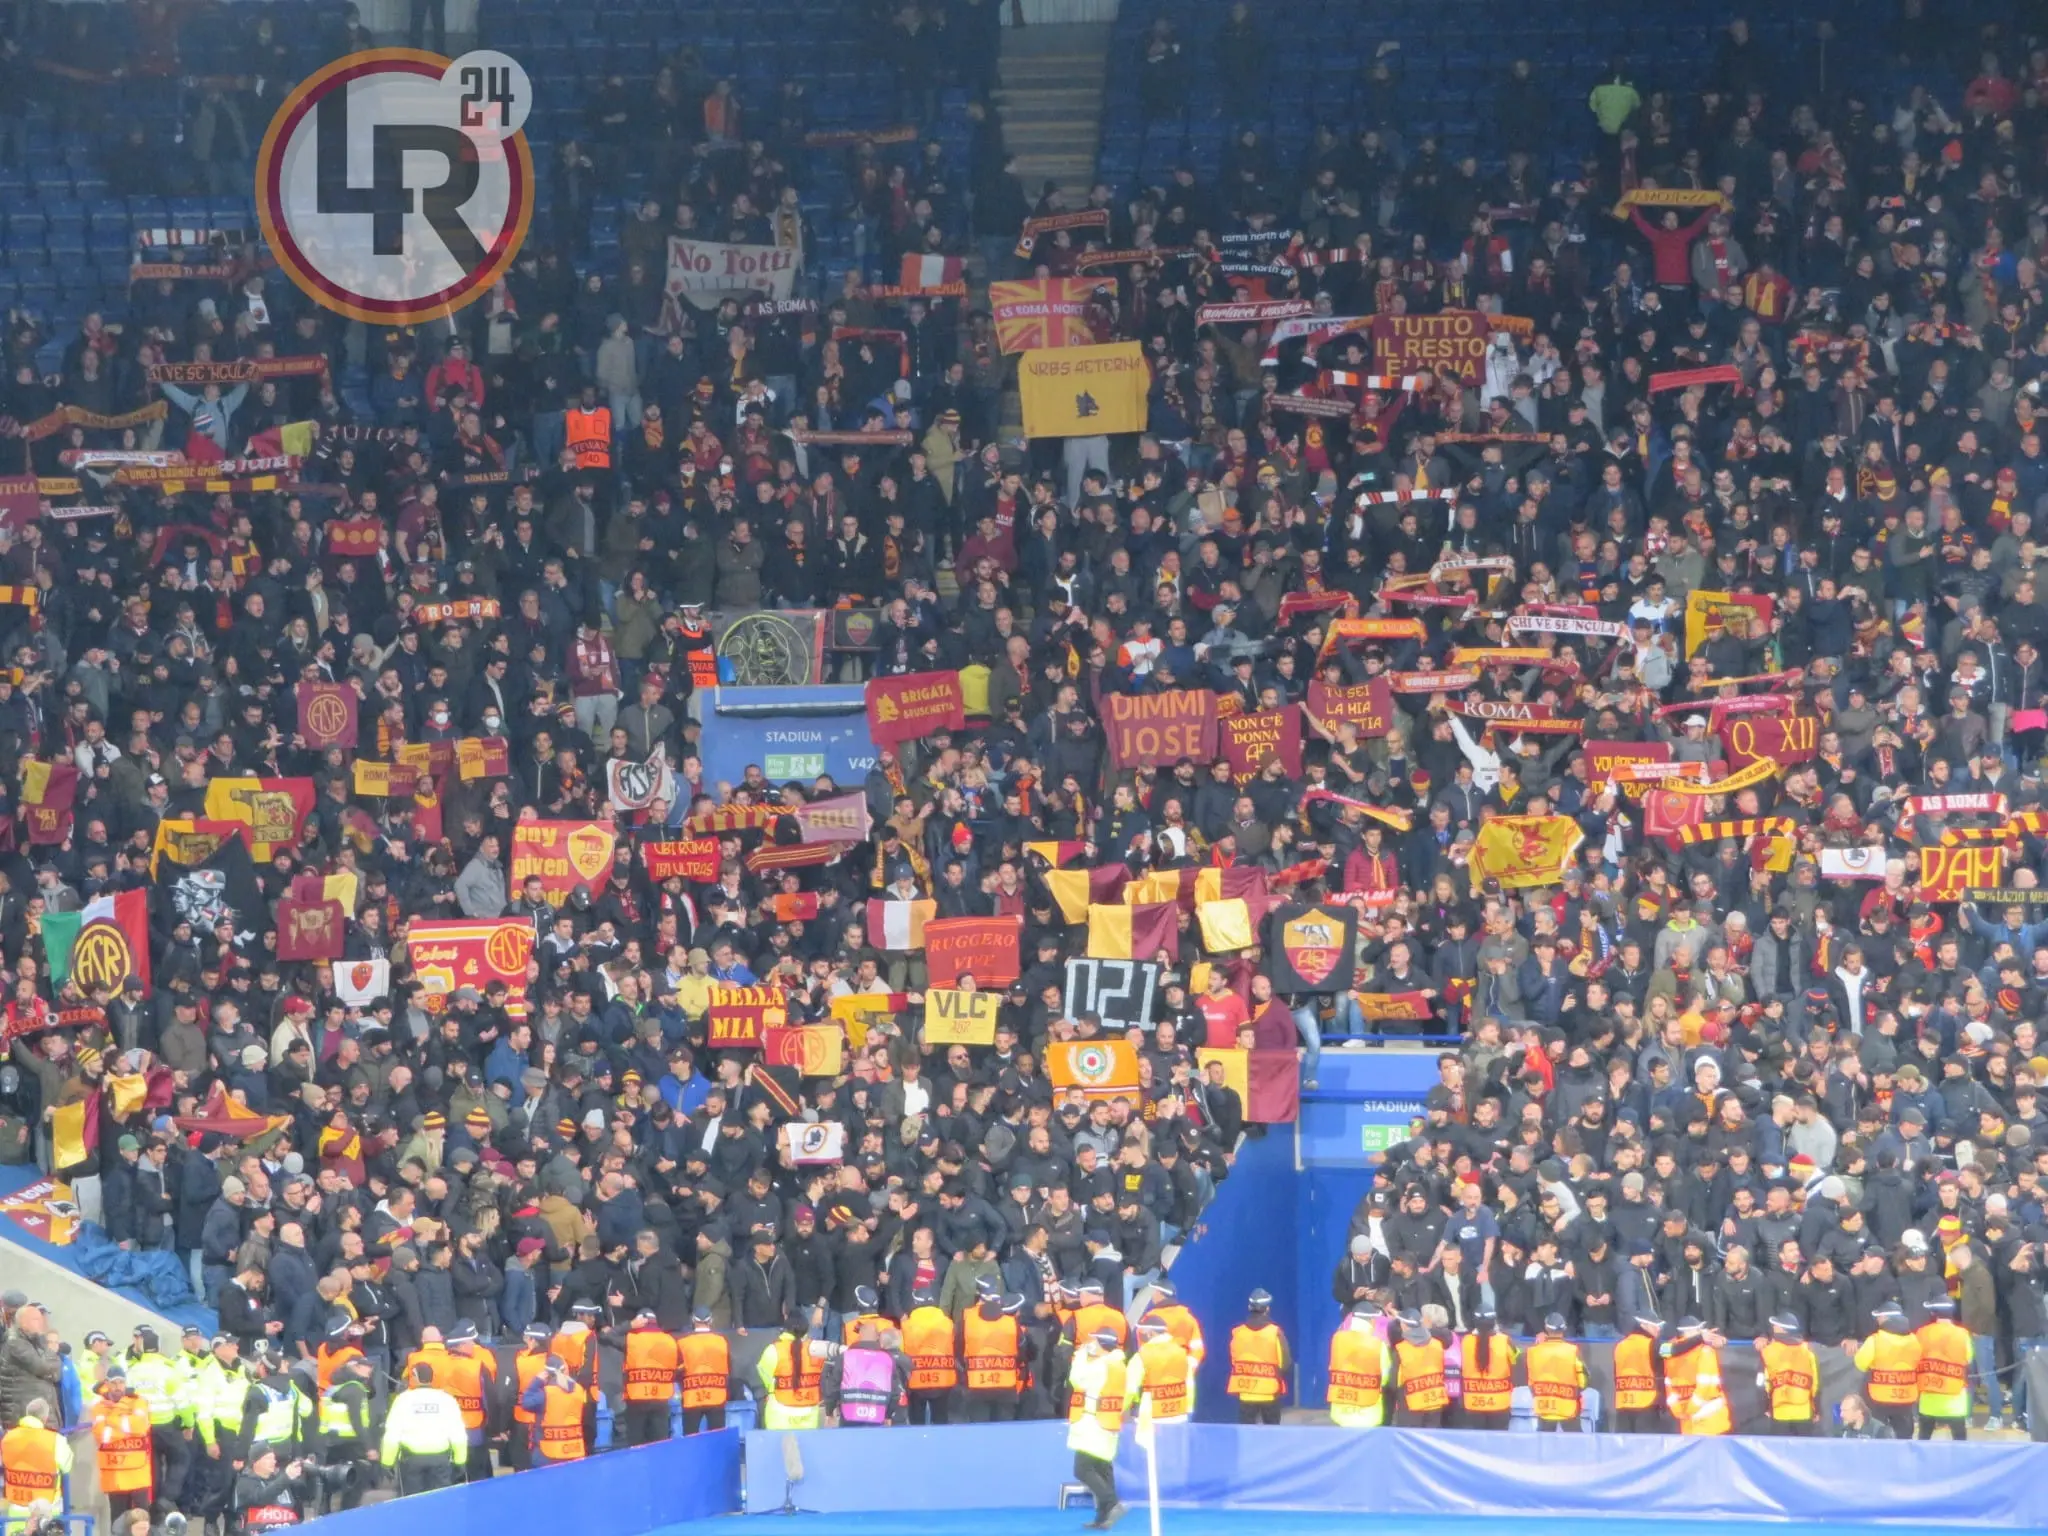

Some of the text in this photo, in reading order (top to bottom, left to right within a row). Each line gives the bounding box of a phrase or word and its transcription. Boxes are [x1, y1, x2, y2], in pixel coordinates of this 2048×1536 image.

[671, 243, 793, 275] No Totti
[758, 299, 807, 315] AS ROMA
[1016, 305, 1049, 317] ROMA
[1052, 304, 1085, 316] NORT
[1389, 316, 1473, 337] TUTTO
[1376, 337, 1487, 358] IL RESTO
[1511, 617, 1534, 629] CHI
[1536, 618, 1553, 630] VE
[1555, 619, 1571, 631] SE
[901, 683, 953, 704] BRIGATA
[1347, 684, 1370, 698] SEI
[1112, 690, 1205, 720] DIMMI
[1326, 702, 1343, 715] LA
[1463, 702, 1533, 719] ROMA
[311, 698, 343, 731] ASR
[1228, 717, 1260, 731] NON
[766, 731, 822, 743] STADIUM
[1233, 730, 1281, 745] DONNA
[1732, 717, 1814, 760] Q XII
[1921, 794, 1989, 811] AS ROMA
[514, 825, 558, 848] any
[514, 856, 568, 880] given
[673, 862, 713, 877] ULTRAS
[1921, 846, 2000, 889] DAM
[930, 932, 1016, 953] RUGGERO
[78, 935, 121, 986] ASR
[711, 986, 785, 1008] BELLA
[933, 990, 988, 1020] VLC
[711, 1016, 756, 1040] MIA
[1363, 1101, 1421, 1113] STADIUM
[1234, 1363, 1276, 1376] EWARD
[1919, 1359, 1965, 1376] TEWARD
[1331, 1373, 1378, 1388] TEWARD
[1464, 1379, 1509, 1392] TEWARD
[1534, 1382, 1574, 1396] EWARD
